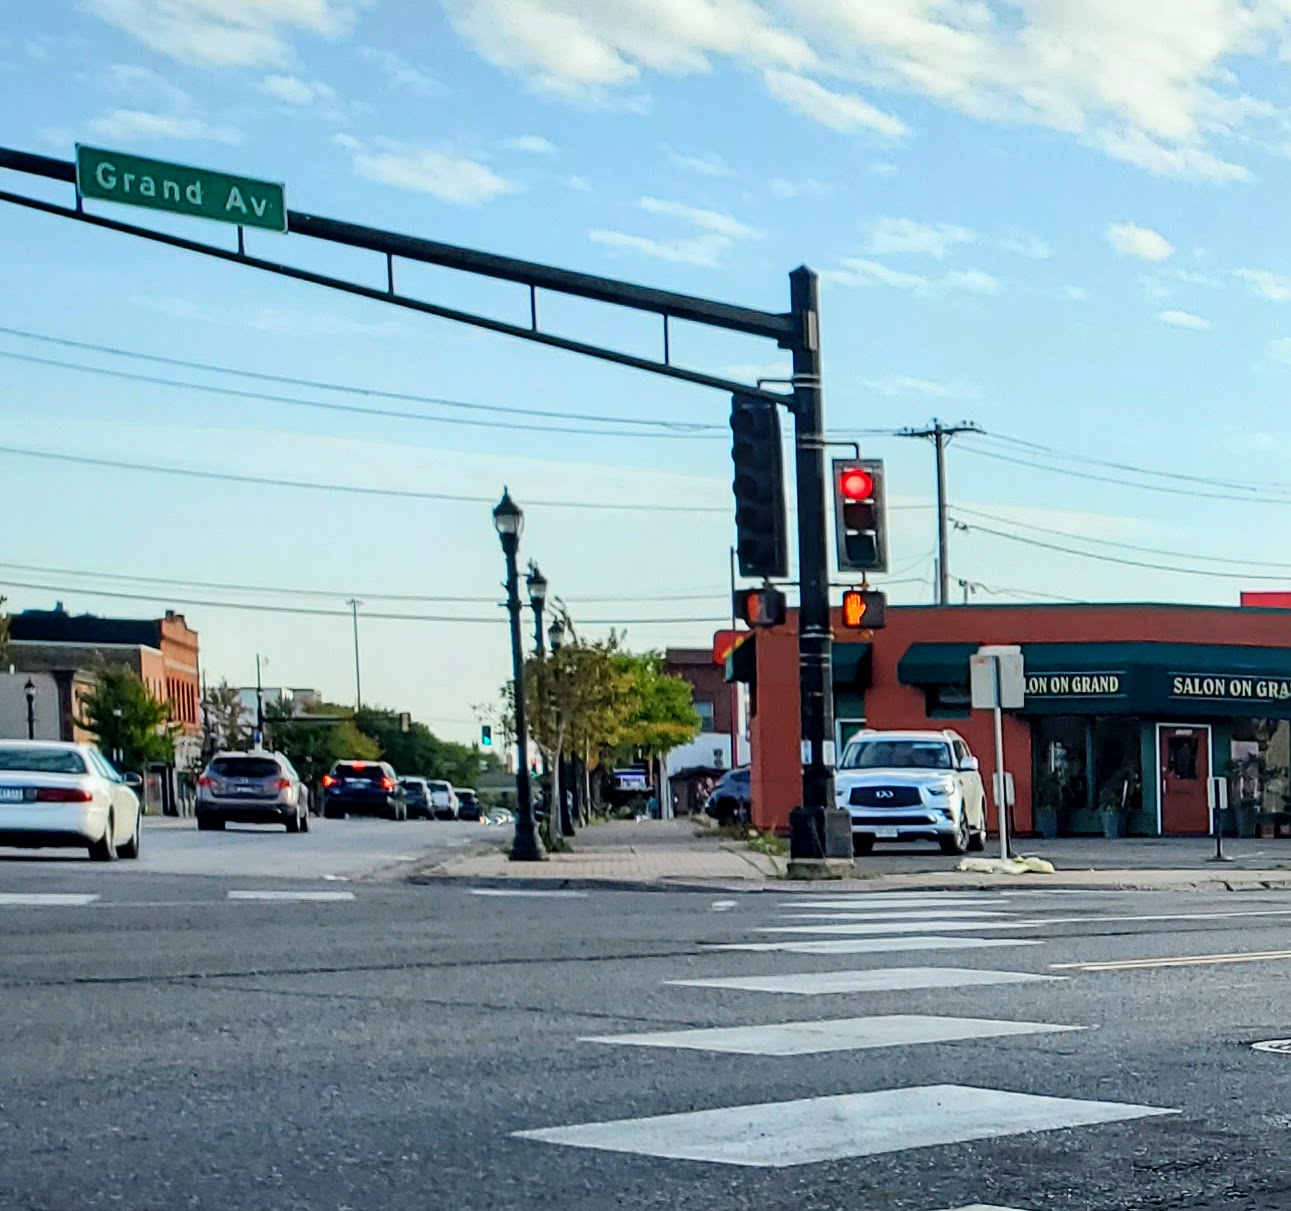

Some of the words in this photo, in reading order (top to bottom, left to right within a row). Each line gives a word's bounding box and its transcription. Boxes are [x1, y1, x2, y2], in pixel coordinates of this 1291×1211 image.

[95, 161, 203, 205] Grand
[225, 186, 267, 217] Av
[1050, 676, 1069, 693] ON
[1072, 676, 1119, 693] GRAND
[1173, 677, 1225, 695] SALON
[1229, 679, 1252, 697] ON
